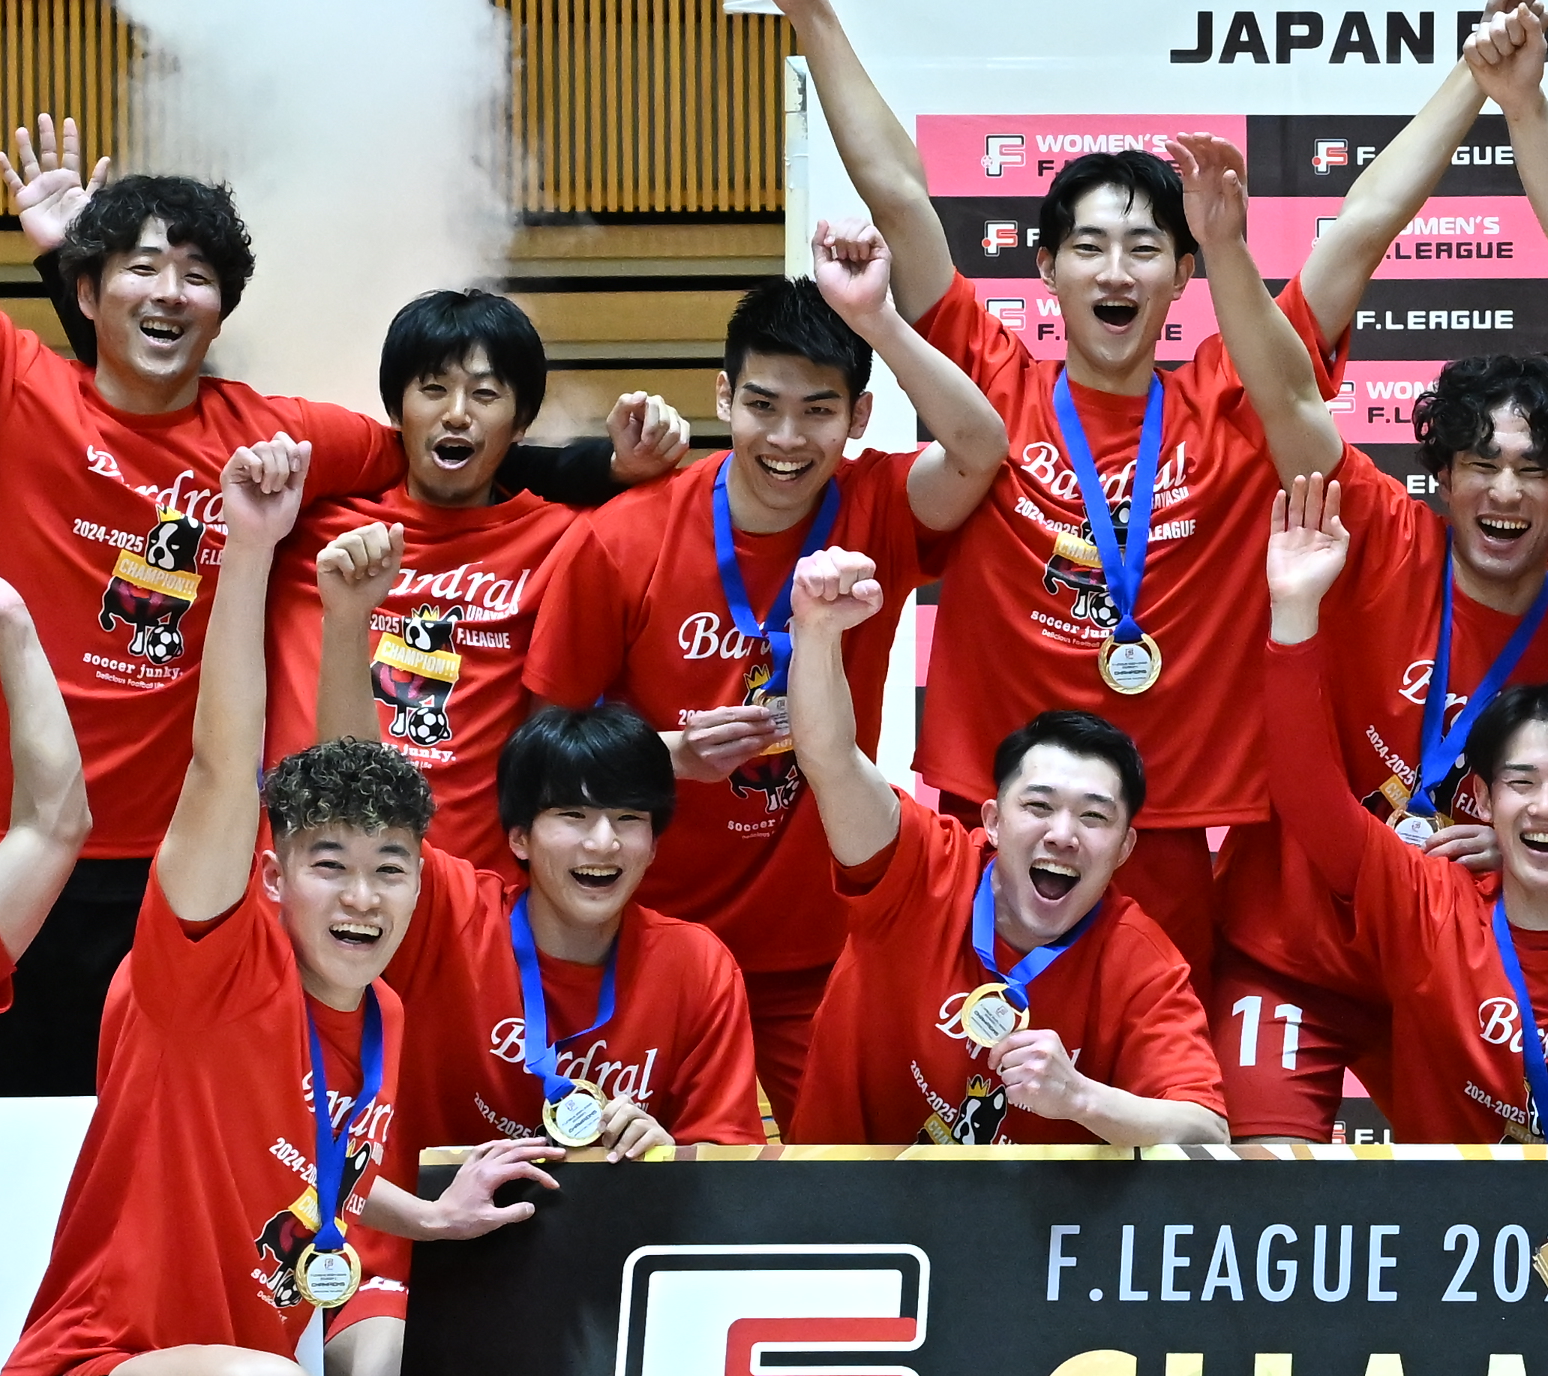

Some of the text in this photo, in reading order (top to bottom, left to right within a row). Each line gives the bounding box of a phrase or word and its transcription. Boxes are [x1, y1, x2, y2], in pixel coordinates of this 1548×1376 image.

[1170, 10, 1435, 65] JAPAN
[1036, 134, 1169, 154] WOMEN'S
[1397, 216, 1500, 236] OMEN'S
[1384, 241, 1514, 260] .LEAGUE
[1356, 311, 1514, 330] F.LEAGUE
[73, 519, 144, 553] 2024-2025
[388, 561, 531, 612] ardral
[456, 628, 511, 649] F.LEAGUE
[82, 653, 184, 681] soccer junky.
[1365, 723, 1416, 786] 2024-2025
[1231, 994, 1304, 1071] 11
[489, 1016, 659, 1102] Brdral
[909, 1059, 958, 1123] 2024-2025
[1464, 1080, 1526, 1124] 2024-2025
[1047, 1223, 1399, 1303] F.LEAGUE
